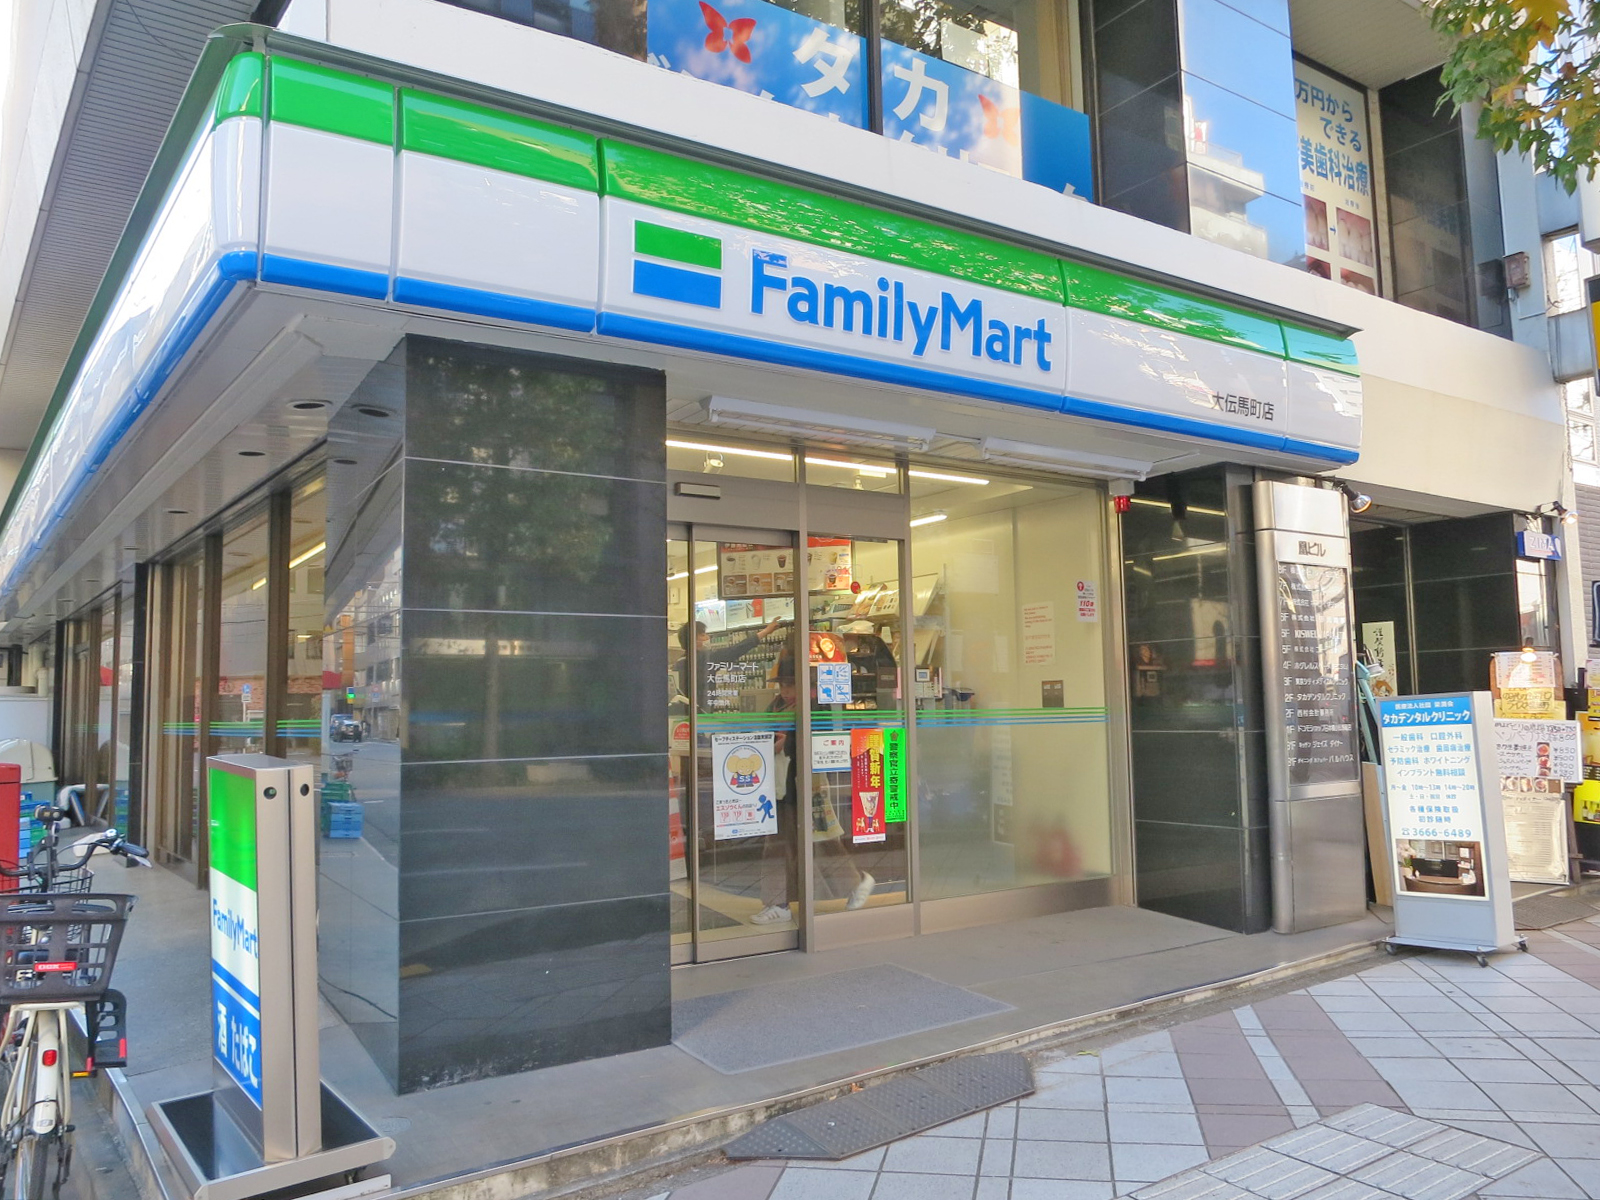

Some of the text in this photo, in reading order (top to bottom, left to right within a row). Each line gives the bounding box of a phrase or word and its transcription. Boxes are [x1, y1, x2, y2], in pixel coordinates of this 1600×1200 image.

[1295, 79, 1353, 122] 万円から
[1320, 117, 1362, 152] できる
[750, 248, 1053, 372] FamilyMart
[1211, 391, 1275, 421] 大伝馬町店
[706, 661, 759, 672] ファミリーマート
[1284, 693, 1294, 703] 2F
[1382, 709, 1471, 725] タカデンタルクリニック
[1393, 731, 1463, 741] 一般歯科 口腔外科
[1387, 744, 1430, 754] セラミック治療
[869, 734, 881, 789] 謹賀新年
[1389, 756, 1472, 766] 予防歯科 ホワイトニング
[1412, 827, 1472, 838] 3666-6489
[212, 897, 260, 959] FamilyMart
[217, 998, 259, 1089] 酒 たばこ
